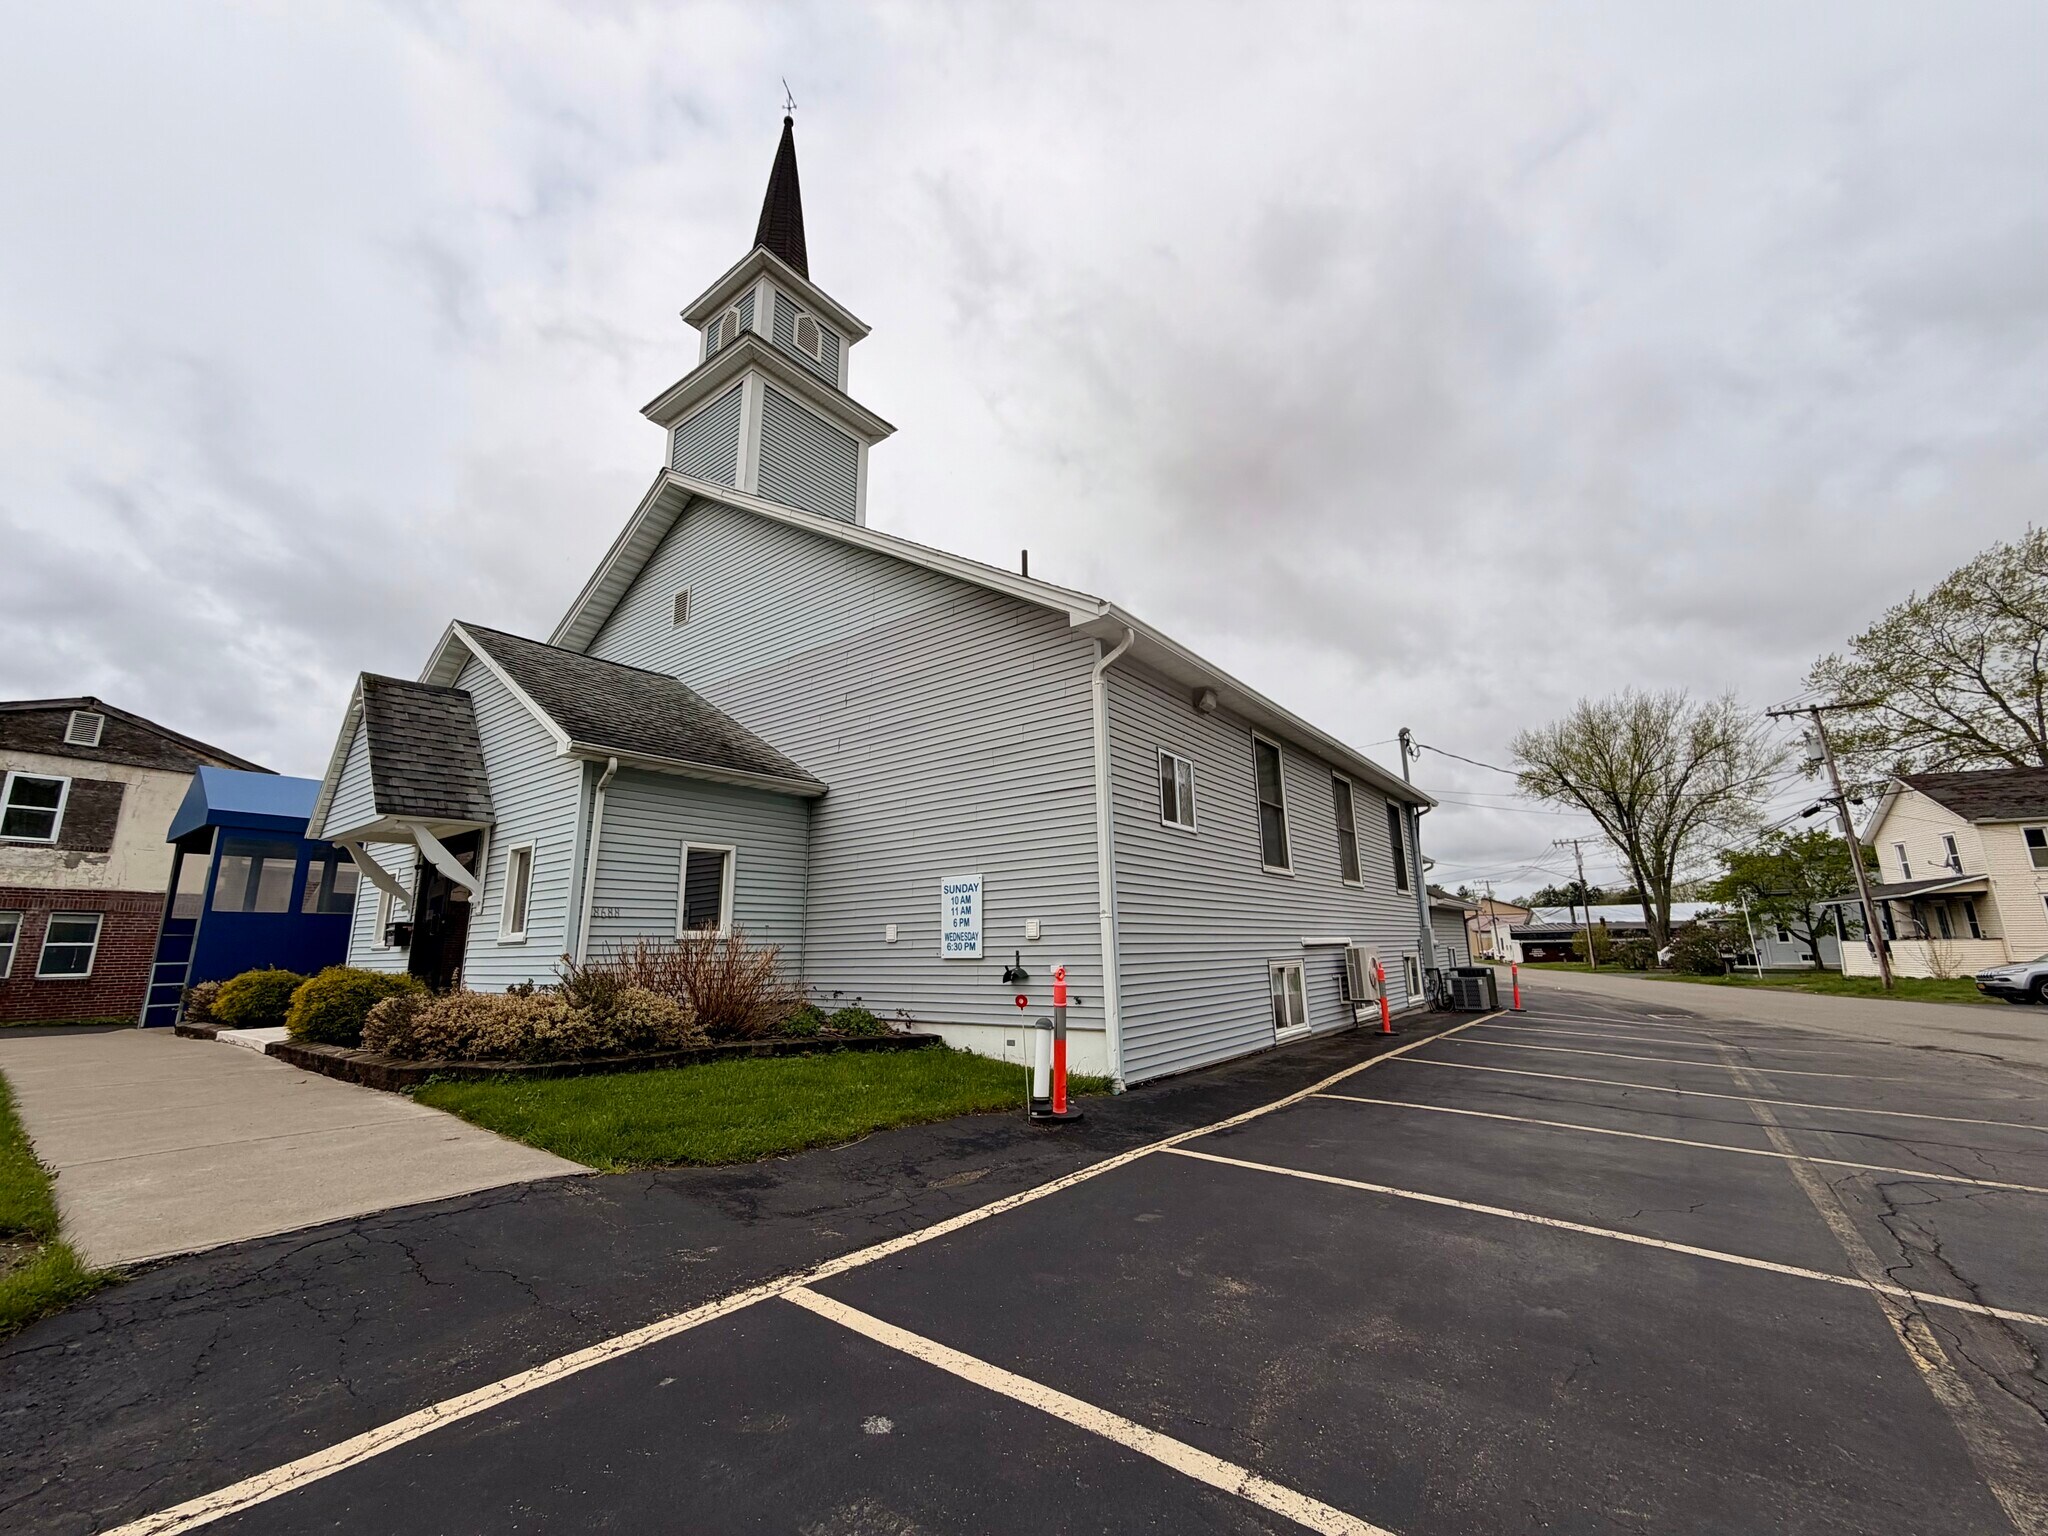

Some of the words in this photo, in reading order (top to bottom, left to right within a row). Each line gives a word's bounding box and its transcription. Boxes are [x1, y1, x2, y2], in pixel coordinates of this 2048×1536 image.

[943, 883, 979, 894] SUNDAY
[951, 896, 959, 905] 10
[960, 895, 971, 904] AM
[951, 907, 959, 915] 11
[960, 906, 971, 915] AM
[953, 918, 957, 927] 6
[959, 918, 970, 927] PM
[944, 931, 979, 941] WEDNESDAY
[946, 942, 962, 951] 6:30
[964, 942, 976, 951] PM
